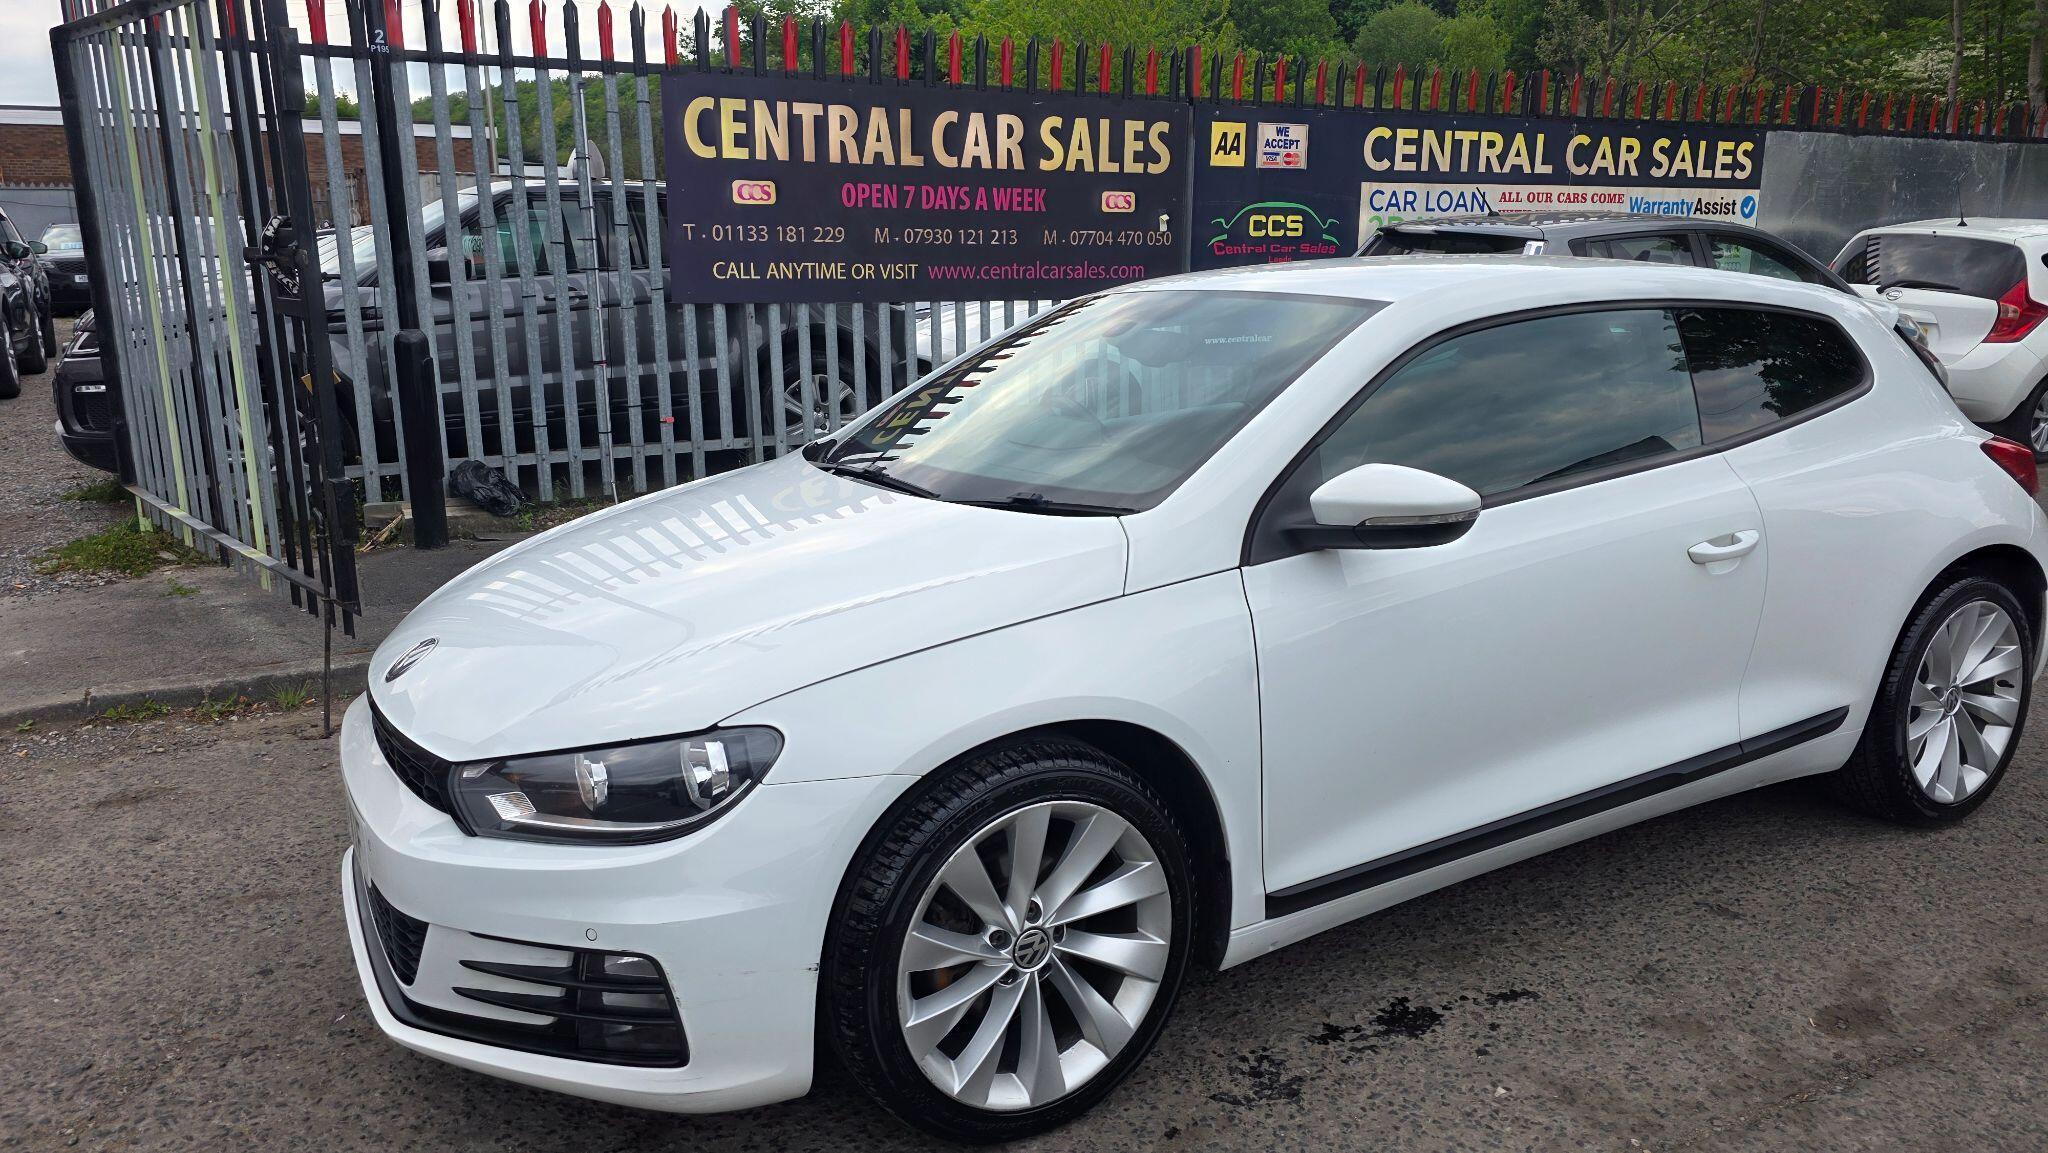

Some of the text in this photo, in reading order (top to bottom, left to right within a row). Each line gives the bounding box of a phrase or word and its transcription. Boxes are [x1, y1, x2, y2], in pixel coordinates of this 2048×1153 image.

[375, 30, 385, 43] 2
[684, 96, 1171, 174] CENTRAL CAR SALES
[1275, 126, 1290, 138] WE
[1214, 131, 1241, 156] AA
[1264, 138, 1301, 150] ACCEPT
[1363, 126, 1755, 180] CENTRAL CAR SALES
[736, 184, 772, 201] CCS
[841, 183, 1047, 212] OPEN 7 DAYS A WEEK
[1369, 189, 1486, 213] CAR LOAN
[1499, 191, 1625, 204] ALL OUR CARS COME
[1629, 196, 1737, 217] WarrantyAssist
[712, 224, 769, 242] 01133
[776, 226, 806, 243] 181
[812, 226, 846, 243] 229
[1248, 214, 1303, 237] CCS
[904, 228, 953, 245] 07930
[958, 228, 984, 245] 121
[990, 229, 1018, 245] 213
[1070, 230, 1113, 246] 07704
[1117, 231, 1143, 246] 470
[1147, 231, 1173, 246] 050
[1213, 241, 1336, 256] Central Car Sales
[712, 261, 1145, 280] CALL ANYTIME OR VISIT www.centralcarsales.com
